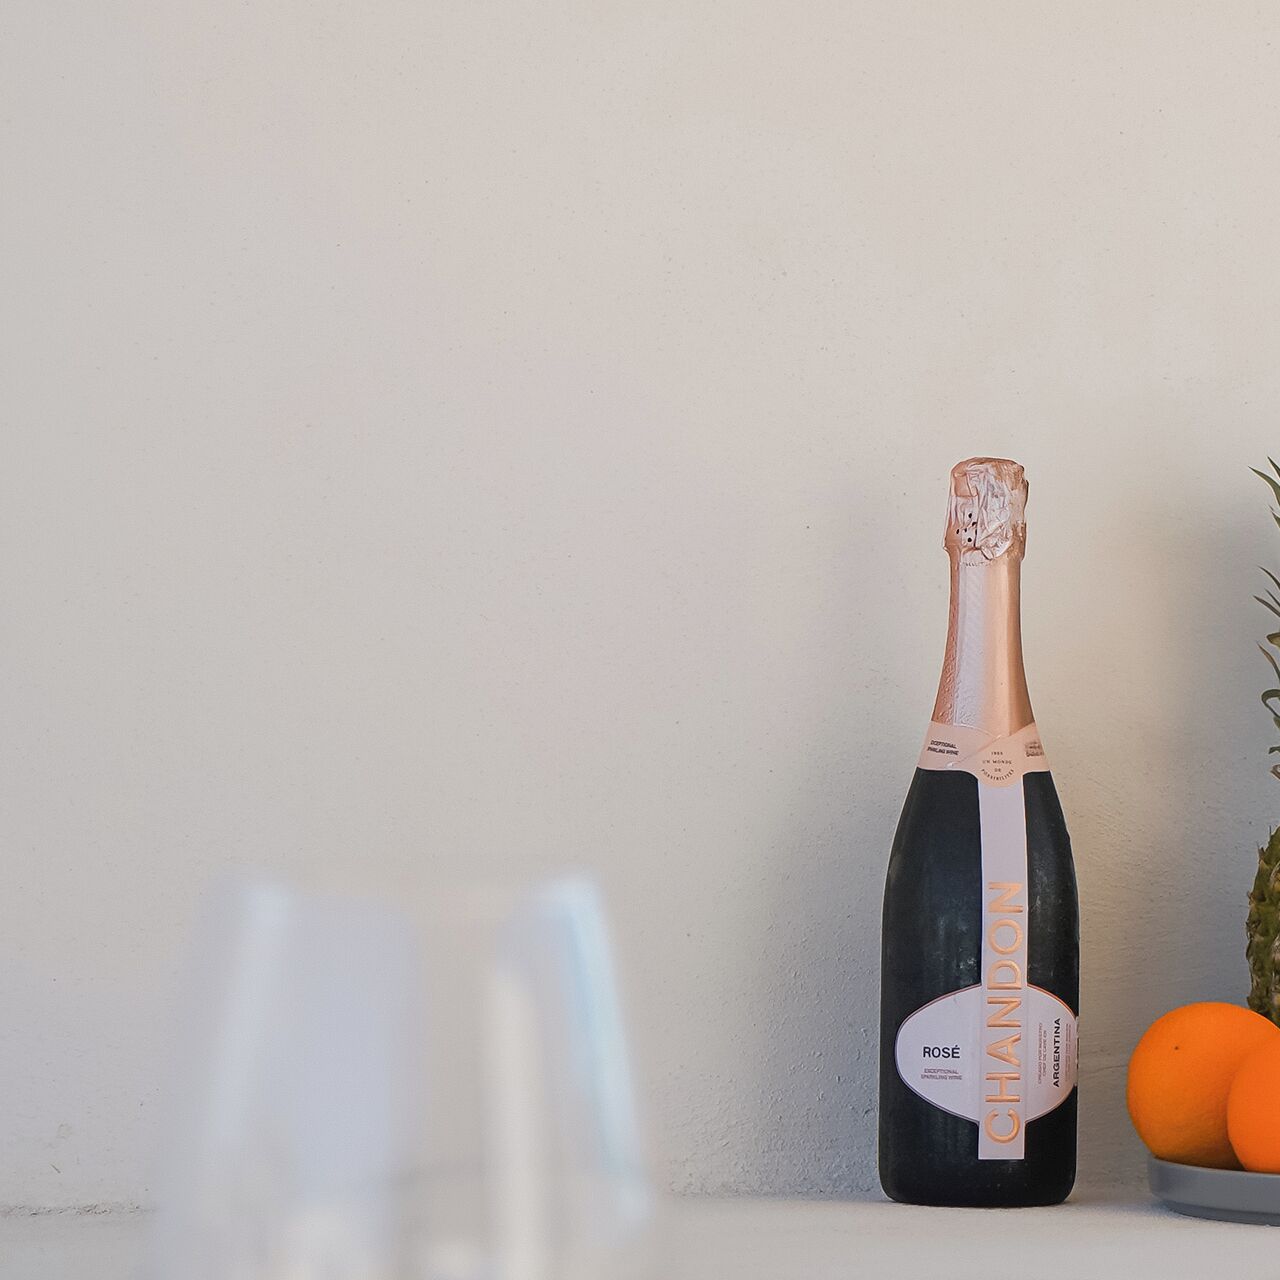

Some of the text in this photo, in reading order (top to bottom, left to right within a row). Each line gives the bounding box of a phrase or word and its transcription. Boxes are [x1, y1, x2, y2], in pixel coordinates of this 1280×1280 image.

[985, 881, 1024, 1144] CHANDON
[922, 1044, 961, 1059] ROSÉ
[1052, 1017, 1062, 1088] ARGENTINA
